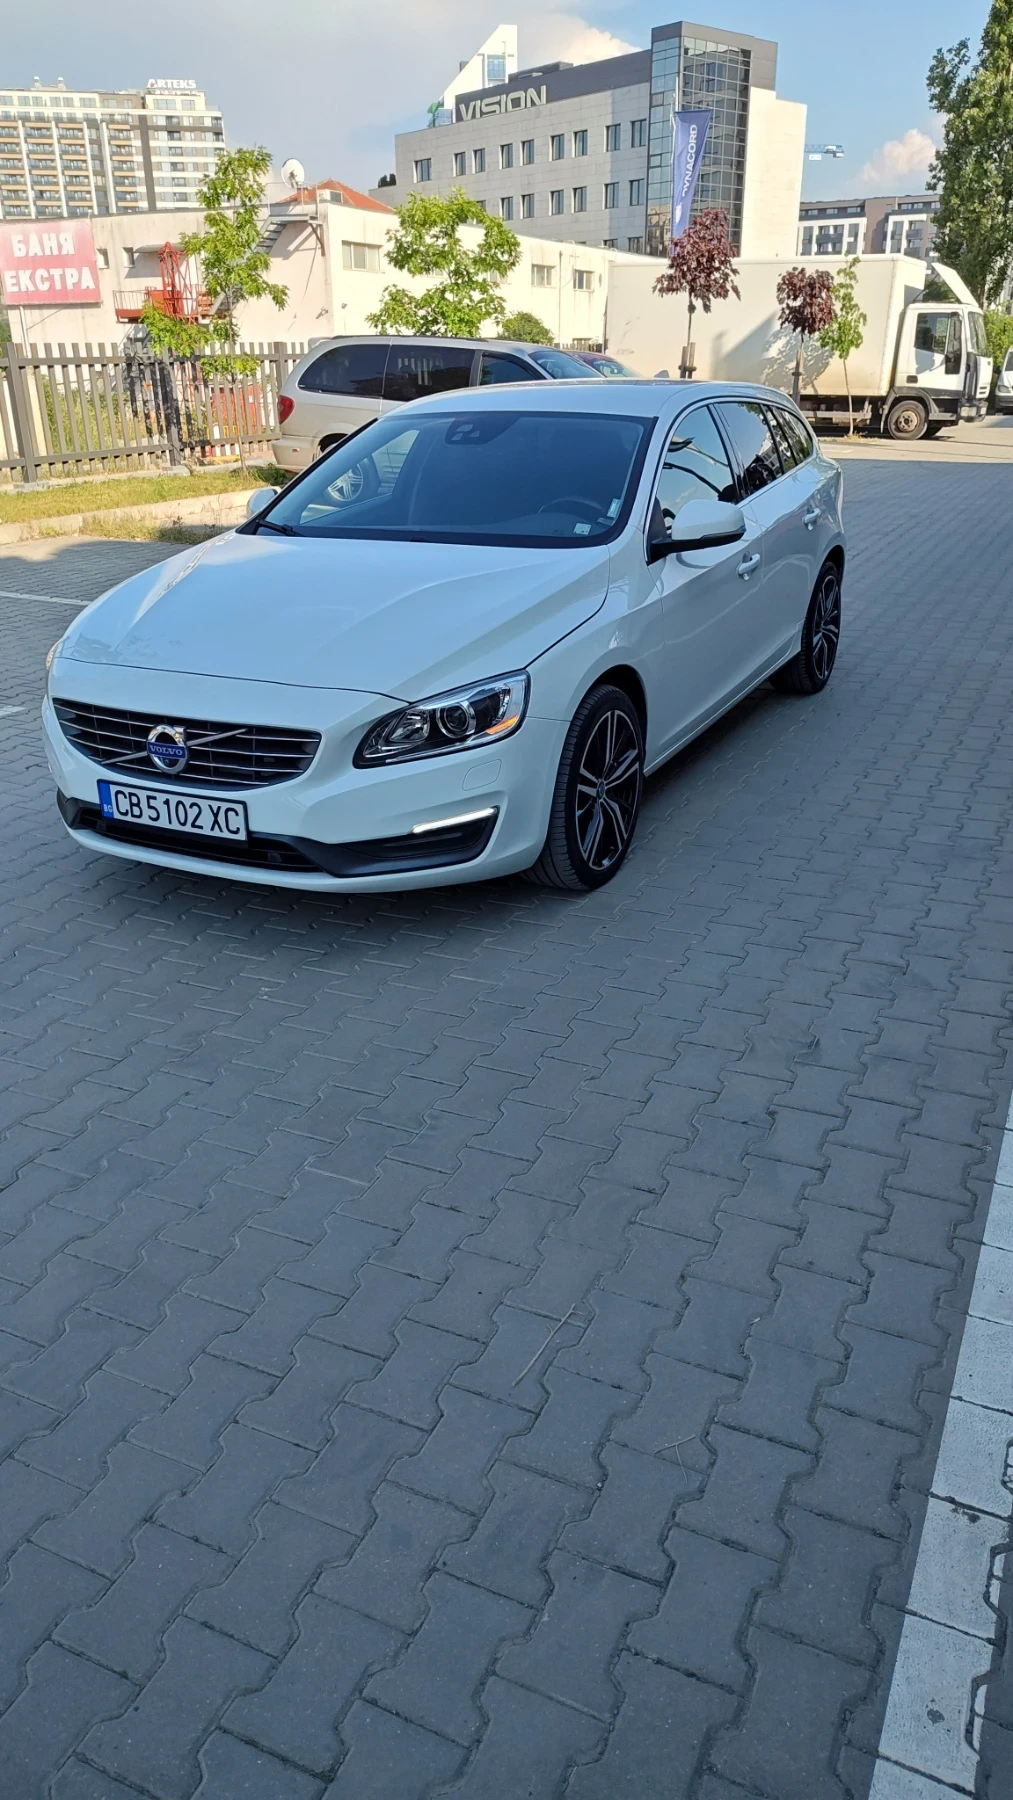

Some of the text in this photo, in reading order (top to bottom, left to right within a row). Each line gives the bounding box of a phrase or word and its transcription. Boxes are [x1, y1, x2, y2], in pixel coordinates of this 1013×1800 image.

[147, 78, 197, 89] ARTEKS
[459, 85, 546, 121] VISION
[11, 232, 76, 258] БАНЯ
[3, 266, 96, 293] ЕКСТРА
[149, 744, 183, 757] VOLVO
[103, 803, 113, 813] BG
